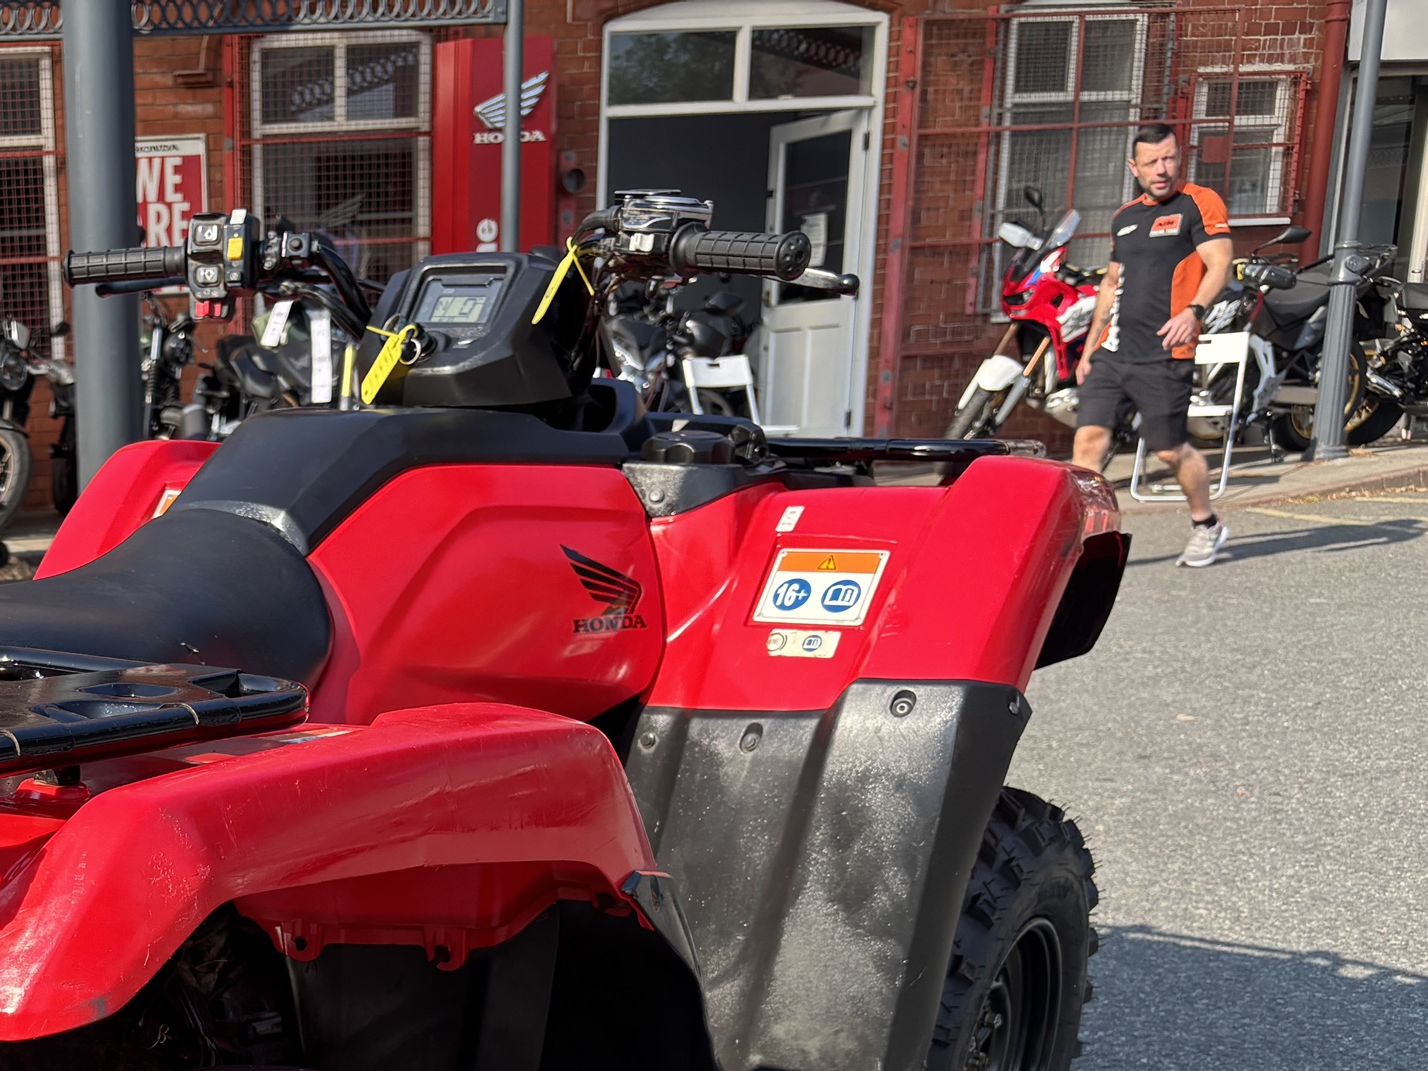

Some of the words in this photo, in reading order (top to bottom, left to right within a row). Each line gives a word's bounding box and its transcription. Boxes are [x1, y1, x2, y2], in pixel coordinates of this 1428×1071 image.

[473, 130, 547, 144] HODA
[135, 156, 184, 204] WE
[137, 201, 191, 248] RE
[775, 583, 808, 607] 16+
[573, 614, 647, 633] HONDA
